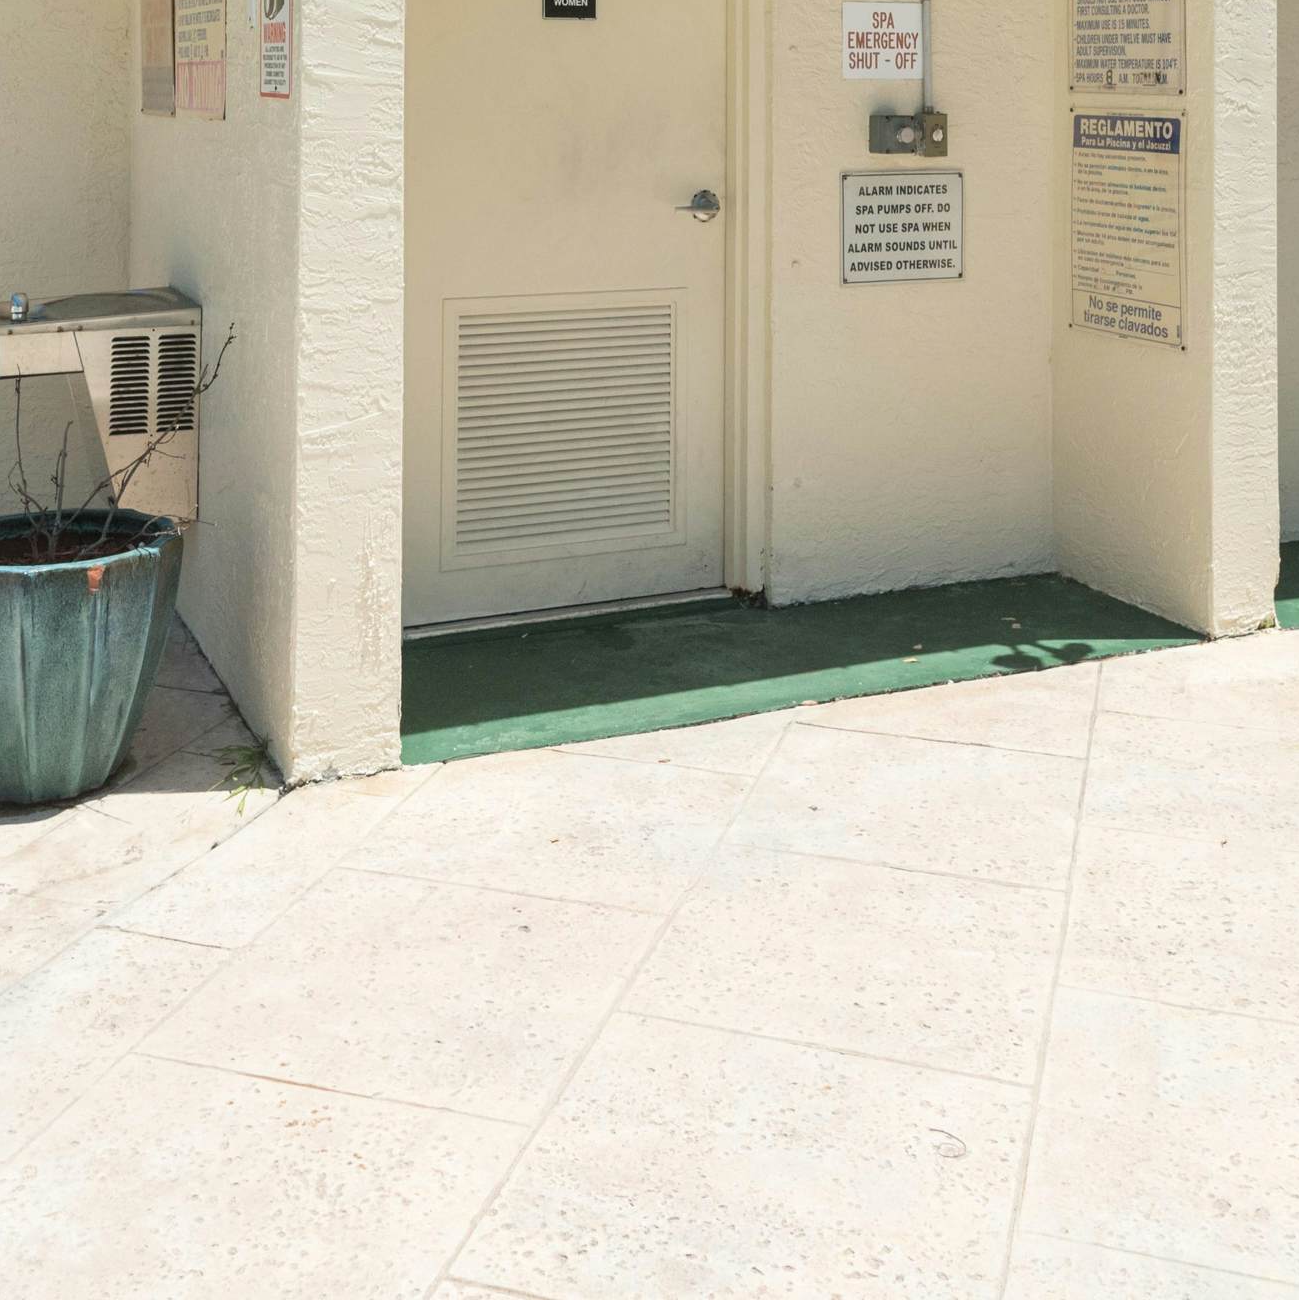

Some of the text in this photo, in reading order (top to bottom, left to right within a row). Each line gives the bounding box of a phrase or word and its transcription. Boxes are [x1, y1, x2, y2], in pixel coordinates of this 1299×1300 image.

[872, 11, 894, 29] SPA
[1076, 20, 1100, 30] MAXIMUM
[1101, 19, 1111, 30] USE
[1111, 19, 1117, 29] IS
[848, 31, 919, 49] EMERGENCY
[1076, 32, 1171, 44] CHILDREN UNDER TWELVE MUST HAVE
[1076, 45, 1092, 56] ADULT
[849, 52, 880, 69] SHUT
[895, 52, 918, 69] OFF
[1076, 59, 1099, 69] MAXIMUM
[1100, 59, 1117, 69] WATER
[1118, 59, 1154, 69] TEMPERATURE
[1076, 73, 1085, 83] SPA
[1086, 73, 1103, 83] HOURS
[1080, 118, 1173, 139] REGLAMENTO
[1081, 136, 1096, 146] Para
[1097, 137, 1105, 146] La
[1106, 138, 1130, 148] Piscina
[1138, 140, 1145, 149] el
[1146, 140, 1171, 150] Jacuzzi
[858, 184, 948, 196] ALARM INDICATES
[855, 203, 950, 215] SPA PUMPS OFF. DO
[855, 221, 951, 234] NOT USE SPA WHEN
[847, 239, 958, 253] ALARM SOUNDS UNTIL
[850, 258, 956, 272] ADVISED OTHERWISE.
[1089, 295, 1162, 321] No se permite
[1084, 309, 1116, 327] tirarse
[1118, 317, 1169, 338] clavados
